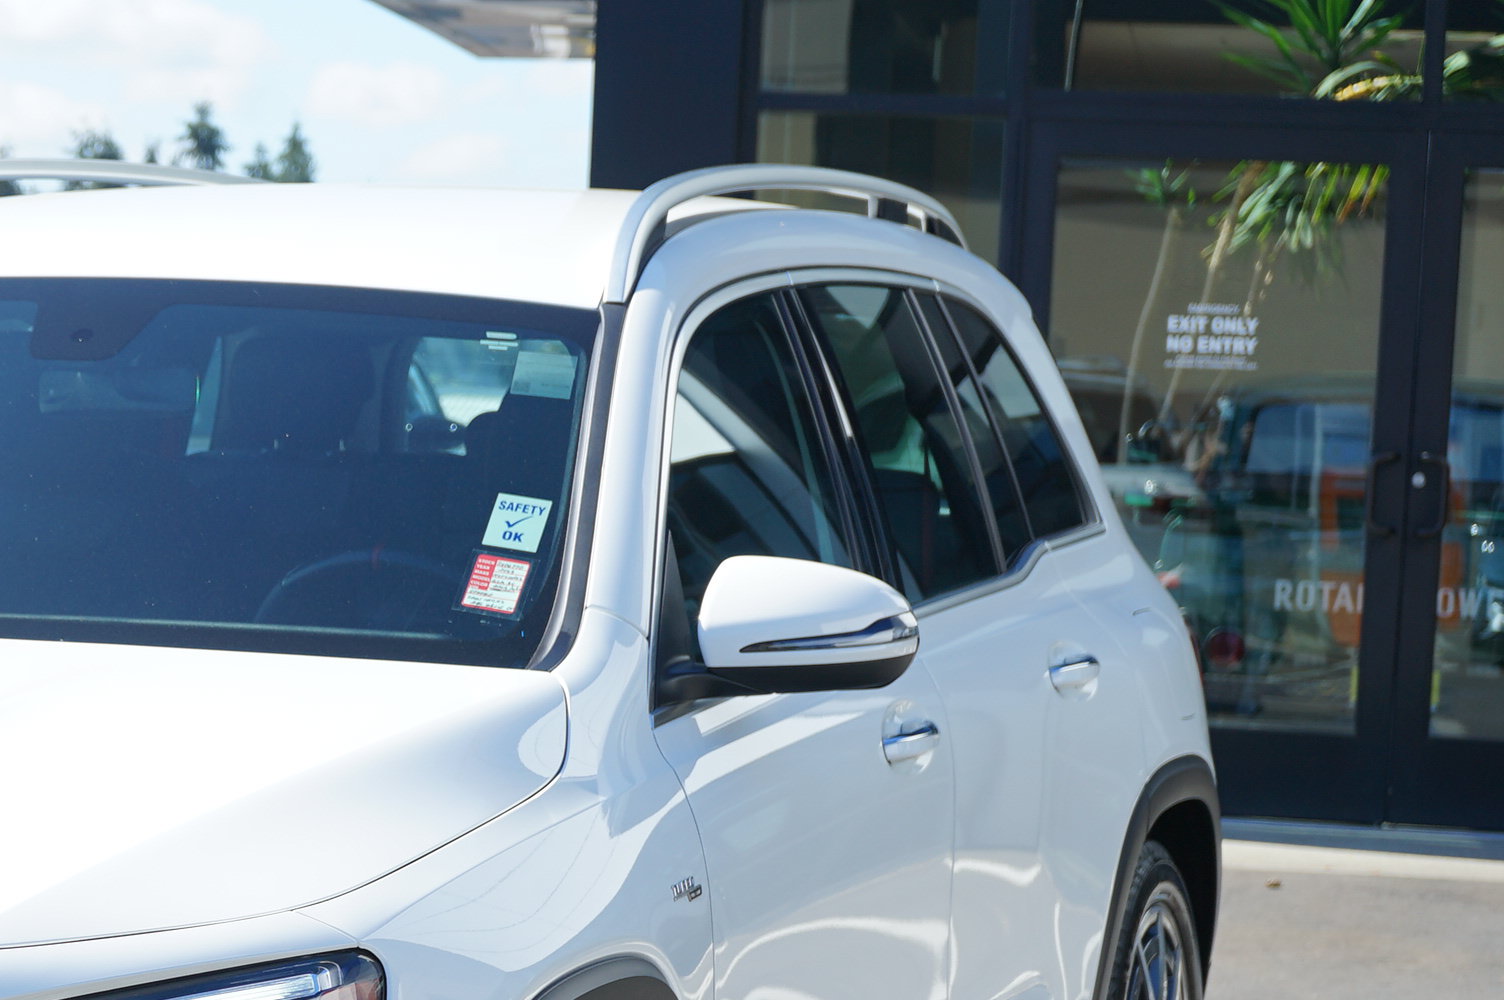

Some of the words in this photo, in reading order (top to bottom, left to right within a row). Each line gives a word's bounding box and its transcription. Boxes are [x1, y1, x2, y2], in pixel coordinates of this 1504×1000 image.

[1167, 314, 1207, 333] EXIT
[1211, 316, 1259, 335] ONLY
[1166, 334, 1194, 353] NO
[1197, 335, 1258, 355] ENTRY
[498, 501, 546, 516] SAFETY
[502, 530, 524, 543] OK
